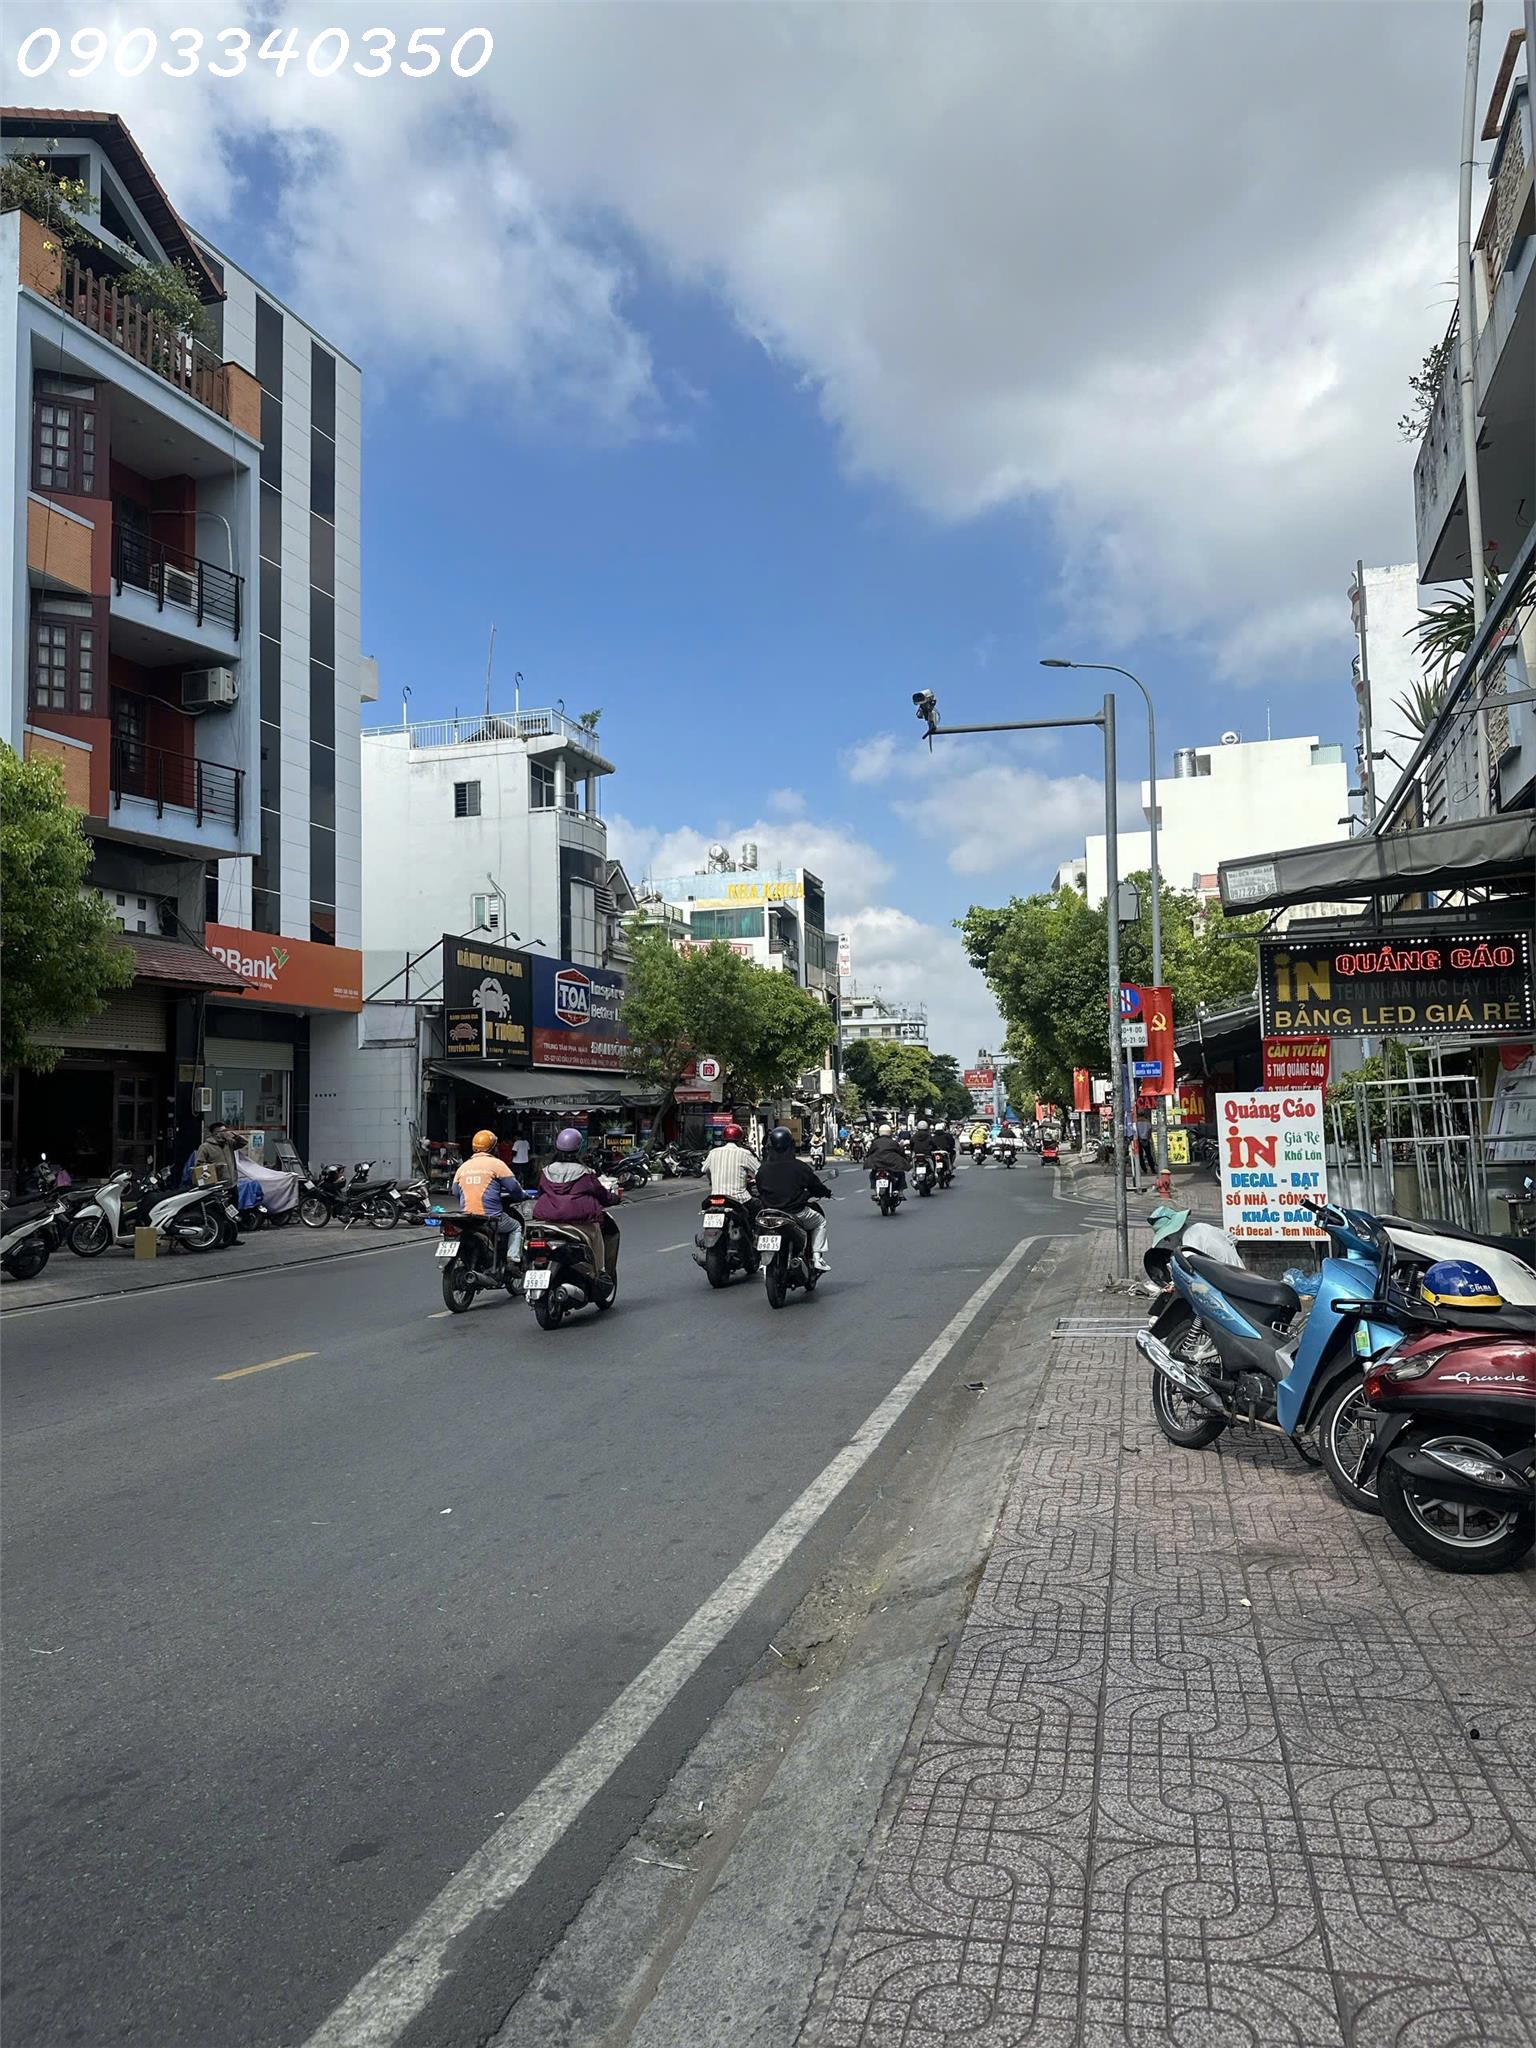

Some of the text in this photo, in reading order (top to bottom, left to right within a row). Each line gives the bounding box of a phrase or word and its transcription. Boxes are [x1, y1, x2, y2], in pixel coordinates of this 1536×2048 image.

[1335, 945, 1441, 976] QUẢNG
[559, 984, 588, 1011] TOA
[590, 980, 625, 1000] Inspire
[590, 1003, 614, 1020] Better
[1275, 994, 1521, 1028] BẢNG LED GIÁ RẺ
[1267, 1058, 1325, 1079] 5 THỢ QUẢNG CÁO
[1224, 1096, 1316, 1123] Quảng Cáo
[1231, 1172, 1277, 1188] DECAL
[1290, 1172, 1320, 1190] BẠT
[1226, 1190, 1241, 1206] SỐ
[1244, 1191, 1268, 1206] NHÀ
[1313, 1193, 1327, 1205] TY
[1242, 1207, 1313, 1223] KHẮC DẤU
[1246, 1226, 1273, 1237] Decal
[1281, 1226, 1301, 1237] Tem
[1438, 1371, 1529, 1385] Grande
